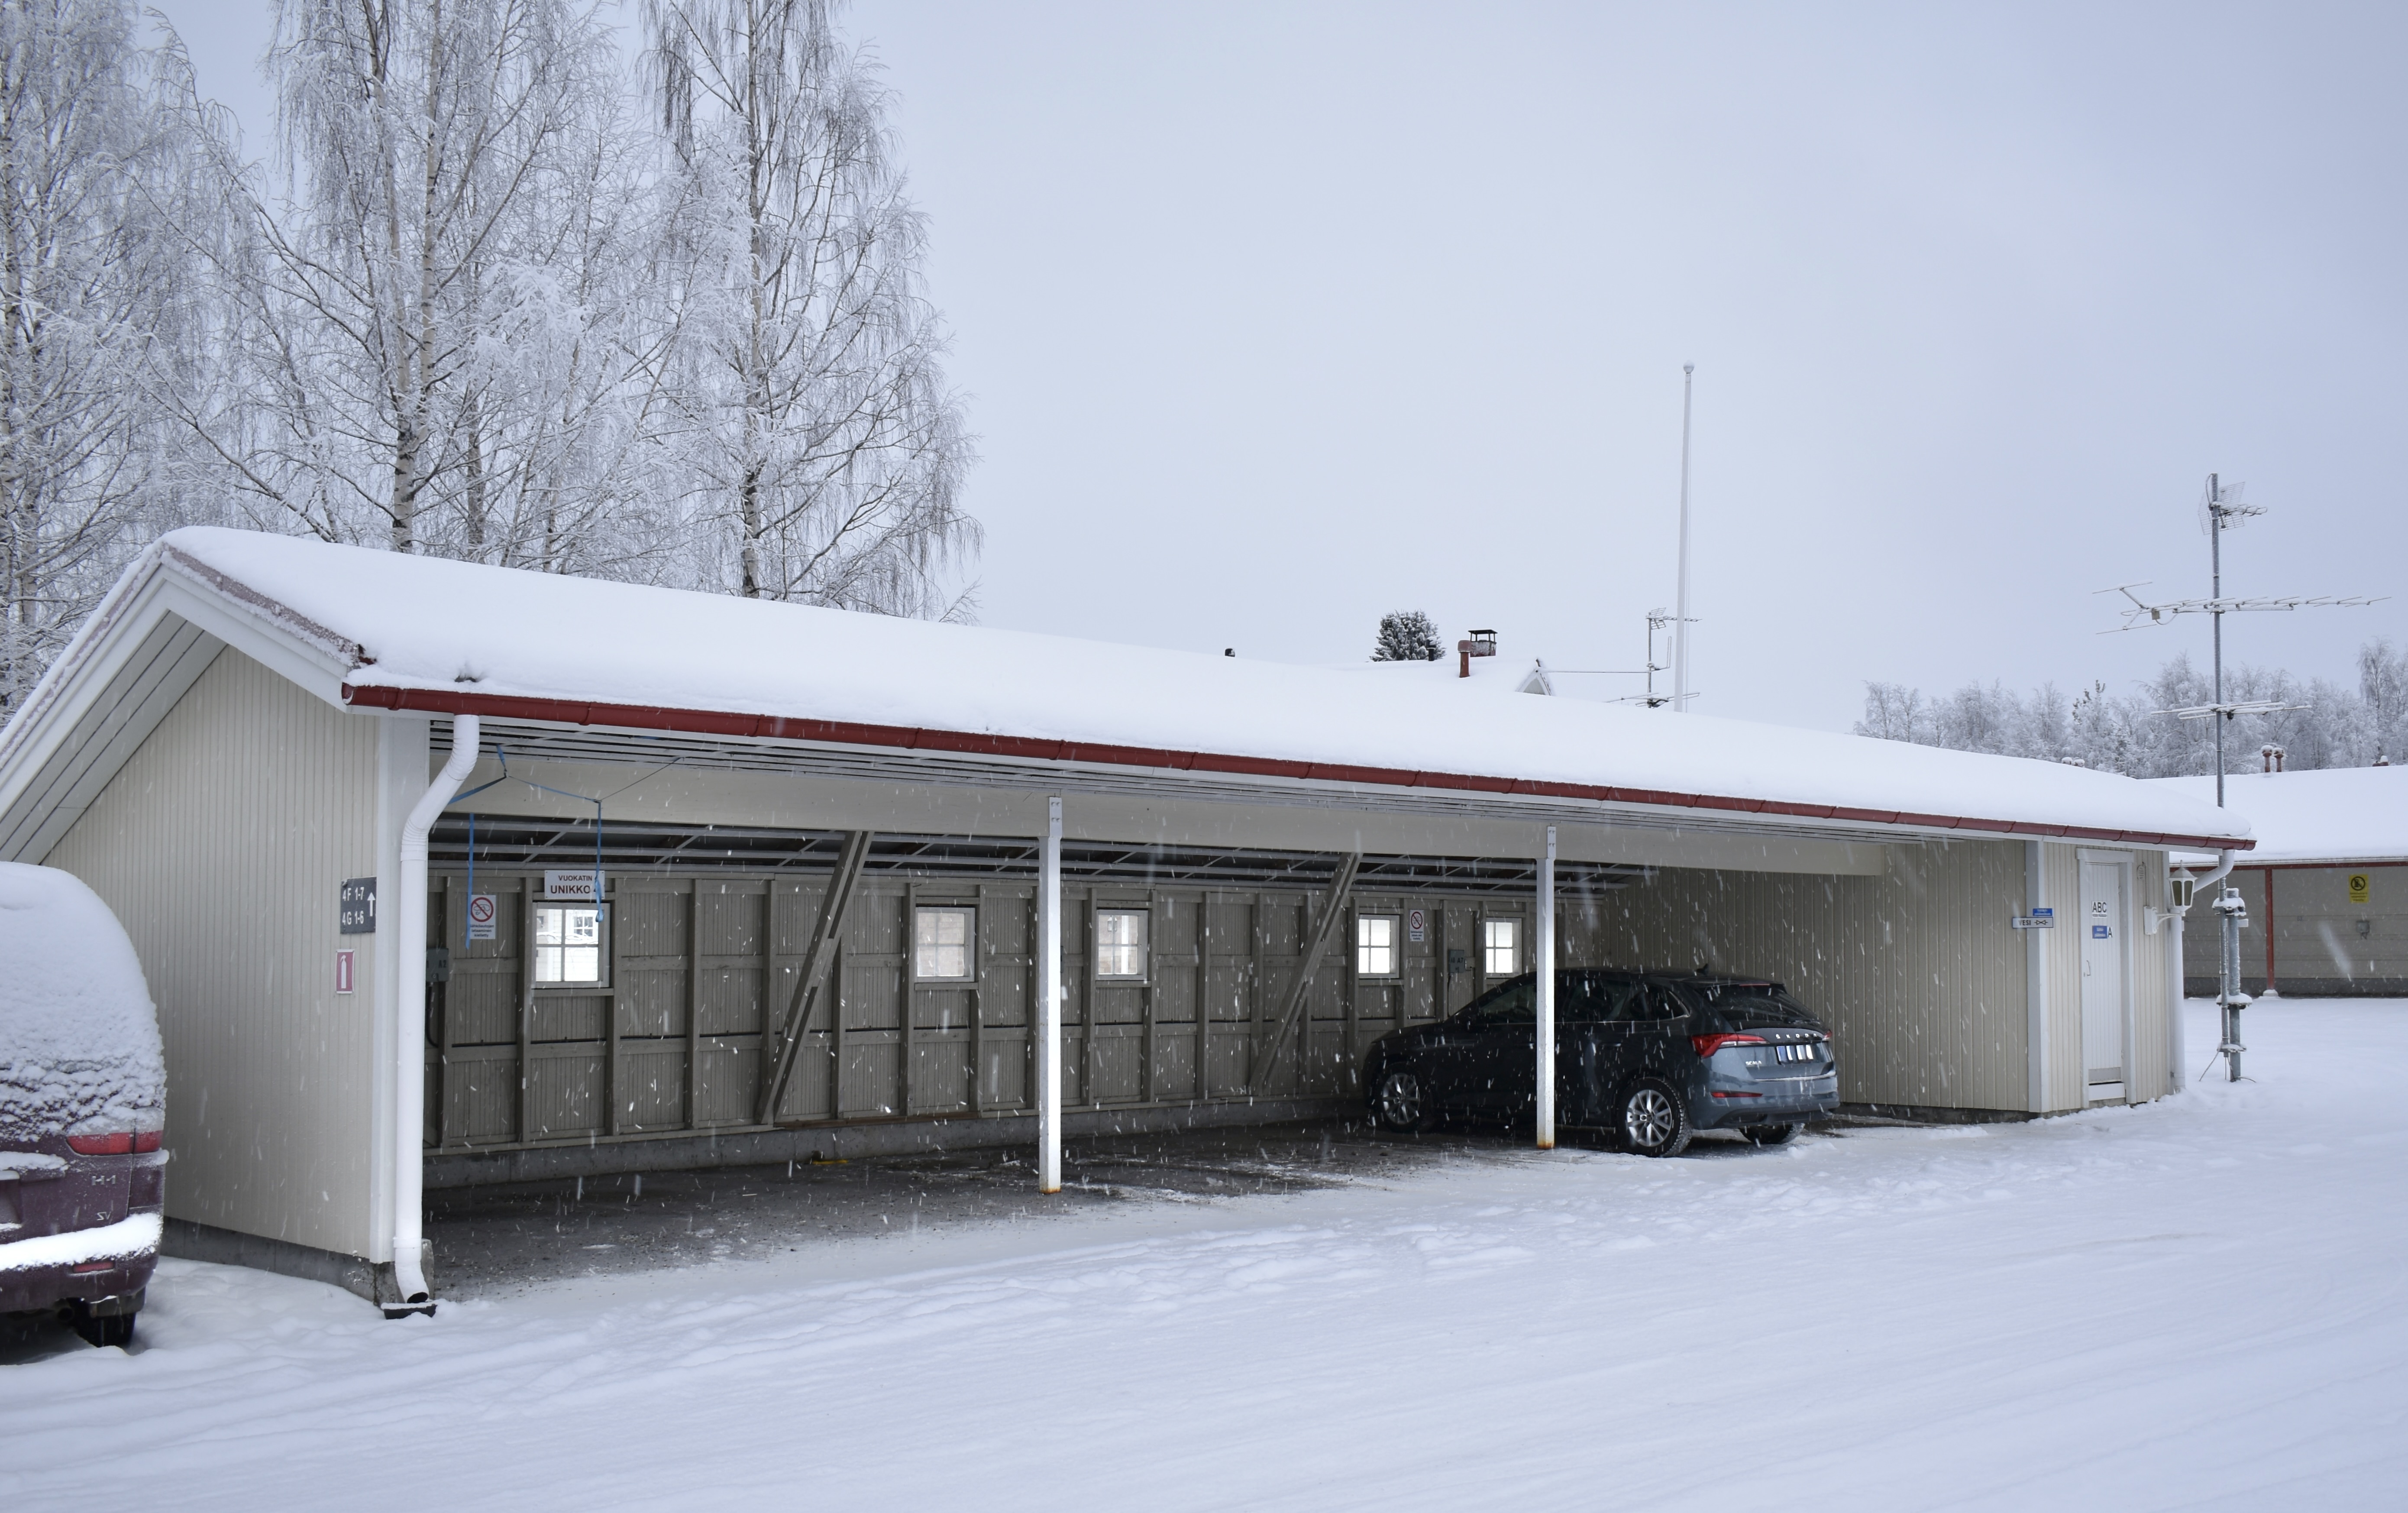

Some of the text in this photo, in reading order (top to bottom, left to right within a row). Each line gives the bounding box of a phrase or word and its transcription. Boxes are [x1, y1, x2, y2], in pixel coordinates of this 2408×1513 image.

[343, 887, 364, 901] 4F 1-7
[550, 885, 591, 894] UNIKKO
[2092, 902, 2107, 913] ABC
[342, 910, 364, 925] 4G 1-6
[2107, 927, 2113, 938] A
[438, 960, 447, 968] A2
